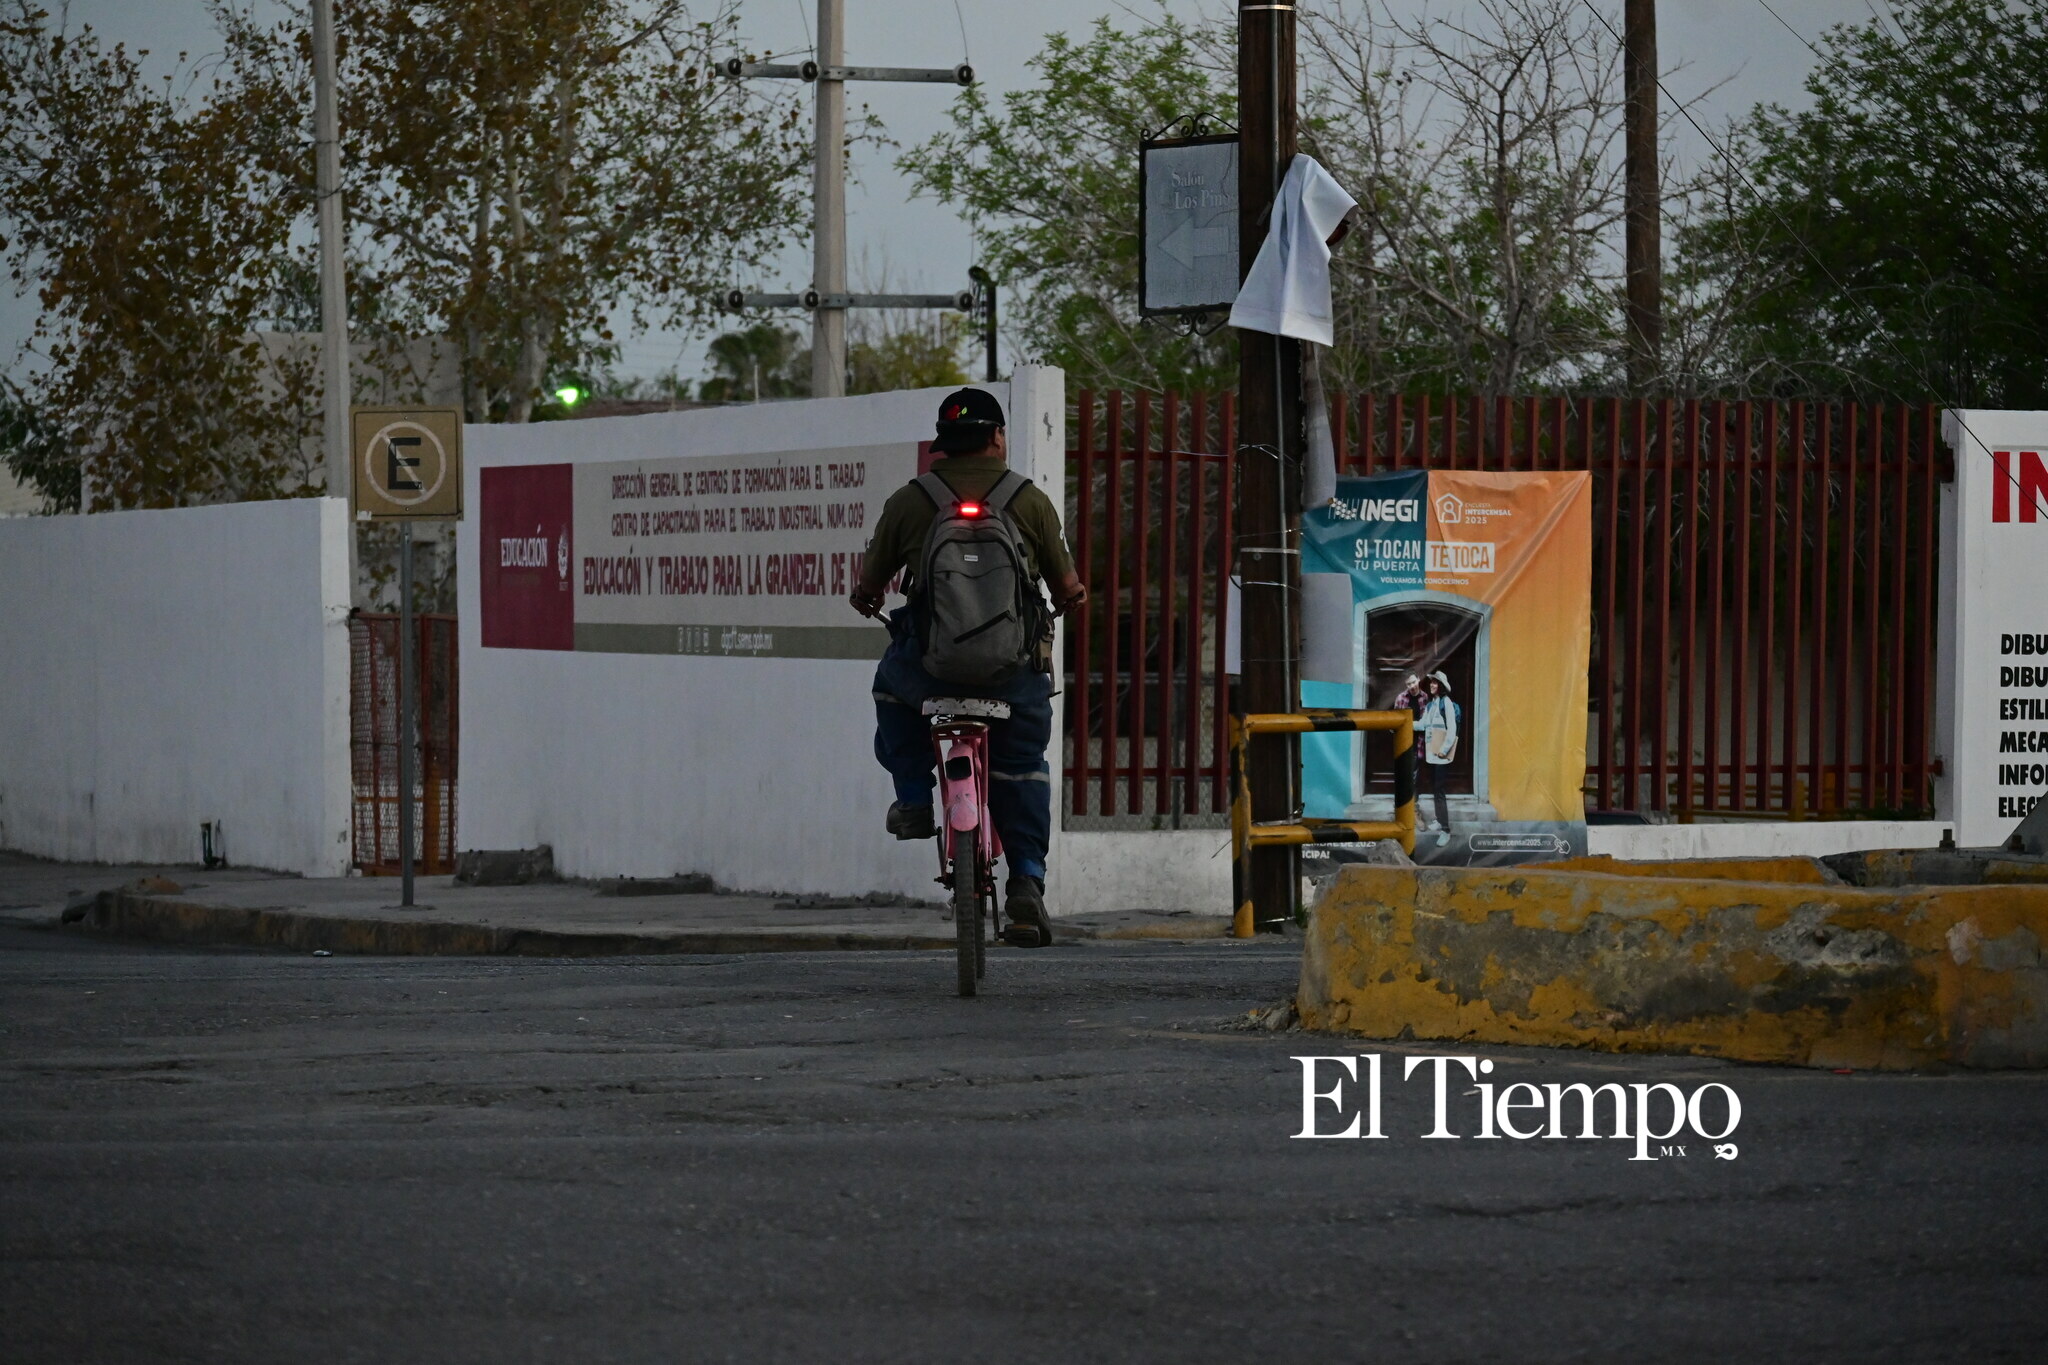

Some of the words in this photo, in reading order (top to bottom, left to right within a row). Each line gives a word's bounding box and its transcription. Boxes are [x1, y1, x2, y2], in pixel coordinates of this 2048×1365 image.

[1174, 191, 1198, 209] Los
[388, 437, 422, 490] E
[612, 465, 646, 500] DIRECCIÓN
[650, 473, 680, 498] GENERAL
[683, 472, 693, 497] DE
[696, 469, 728, 495] CENTROS
[732, 469, 741, 494] DE
[745, 458, 787, 494] FORMACIÓN
[790, 466, 811, 491] PARA
[815, 465, 824, 490] EL
[828, 462, 865, 489] TRABAJO
[612, 513, 638, 537] CENTRO
[641, 512, 650, 537] DE
[653, 503, 701, 536] CAPACITACIÓN
[704, 508, 727, 533] PARA
[729, 508, 737, 533] EL
[741, 507, 776, 532] TRABAJO
[779, 504, 823, 531] INDUSTRIAL
[848, 501, 864, 529] 009
[1360, 499, 1418, 522] INEGI
[1465, 516, 1488, 525] 2025
[500, 523, 548, 567] EDUCACIÓN
[1355, 539, 1369, 559] SI
[1374, 539, 1421, 560] TOCAN
[1430, 544, 1450, 569] TE
[1452, 544, 1490, 569] TOCA
[583, 545, 641, 595] EDUCACIÓN
[645, 557, 654, 595] Y
[658, 556, 709, 596] TRABAJO
[712, 555, 743, 595] PARA
[747, 554, 763, 595] LA
[766, 553, 827, 596] GRANDEZA
[830, 553, 846, 595] DE
[1354, 560, 1369, 571] TU
[1373, 560, 1421, 572] PUERTA
[1380, 577, 1417, 585] VOLVAMOS
[1417, 577, 1425, 585] A
[1424, 578, 1469, 586] CONOCERNOS
[1998, 764, 2048, 786] INFO
[1998, 795, 2043, 818] ELEC
